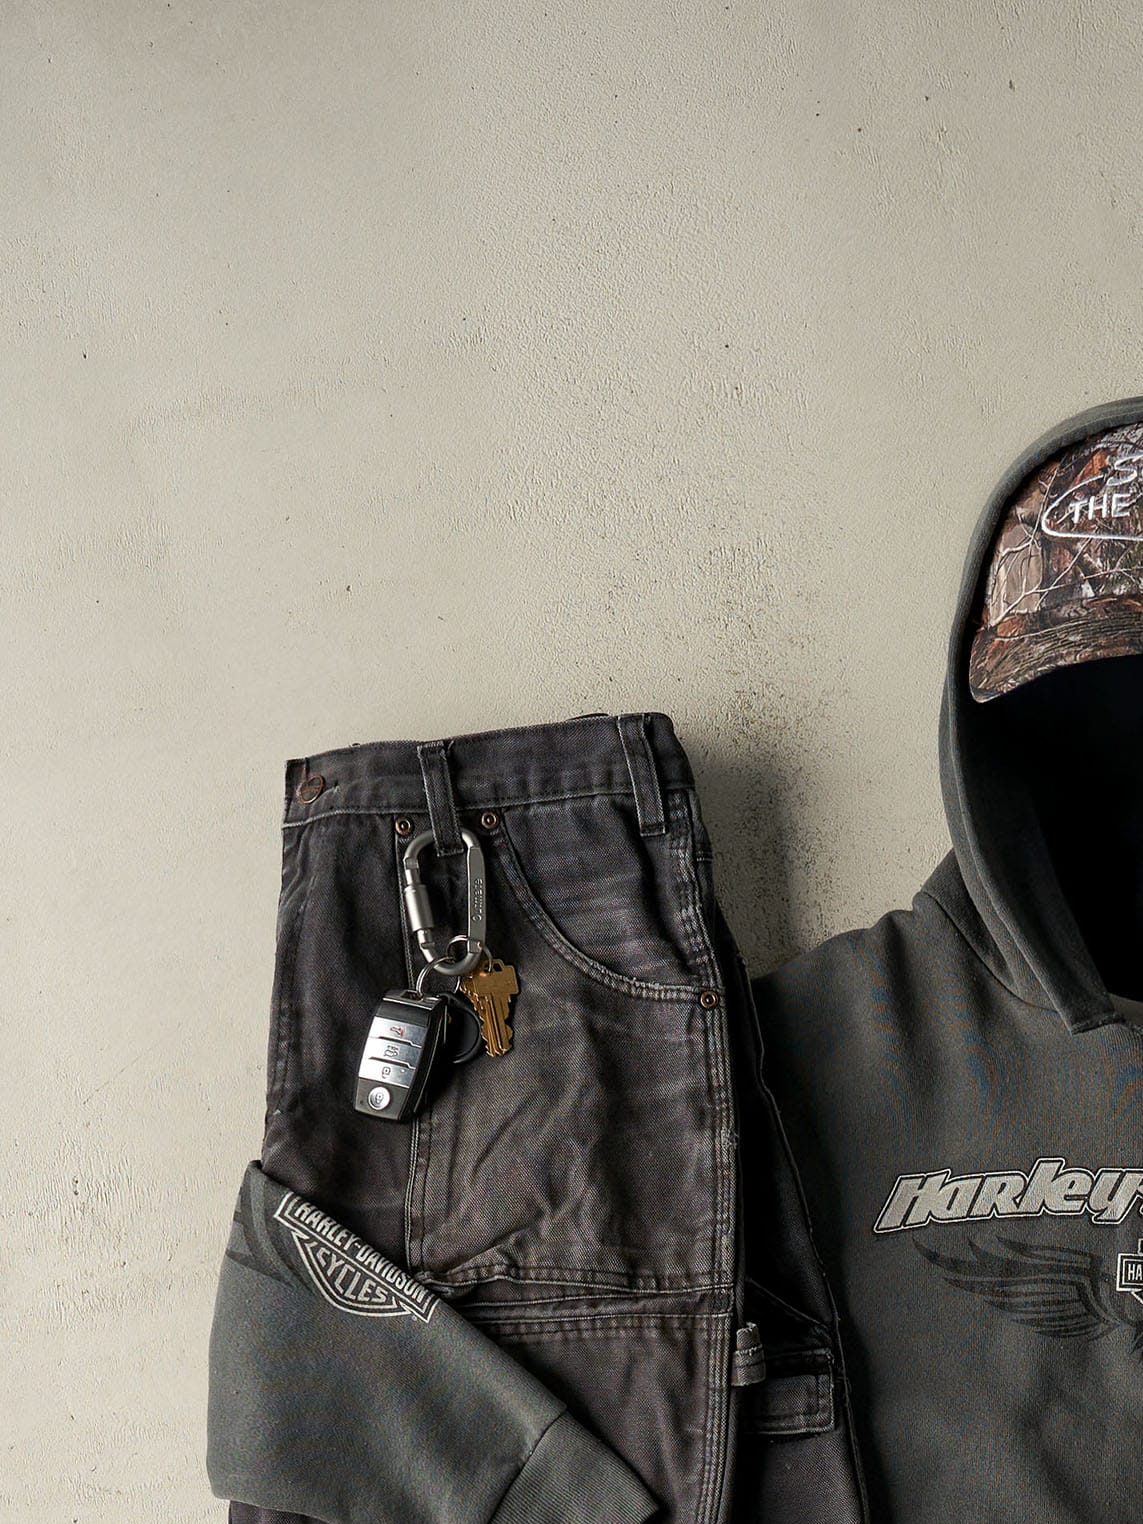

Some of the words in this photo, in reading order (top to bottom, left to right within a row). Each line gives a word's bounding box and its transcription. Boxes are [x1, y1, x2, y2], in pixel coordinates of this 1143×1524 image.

[1070, 493, 1131, 524] THE
[293, 1200, 429, 1305] HARLEY-DAVIDSON
[315, 1247, 389, 1303] CYCLES
